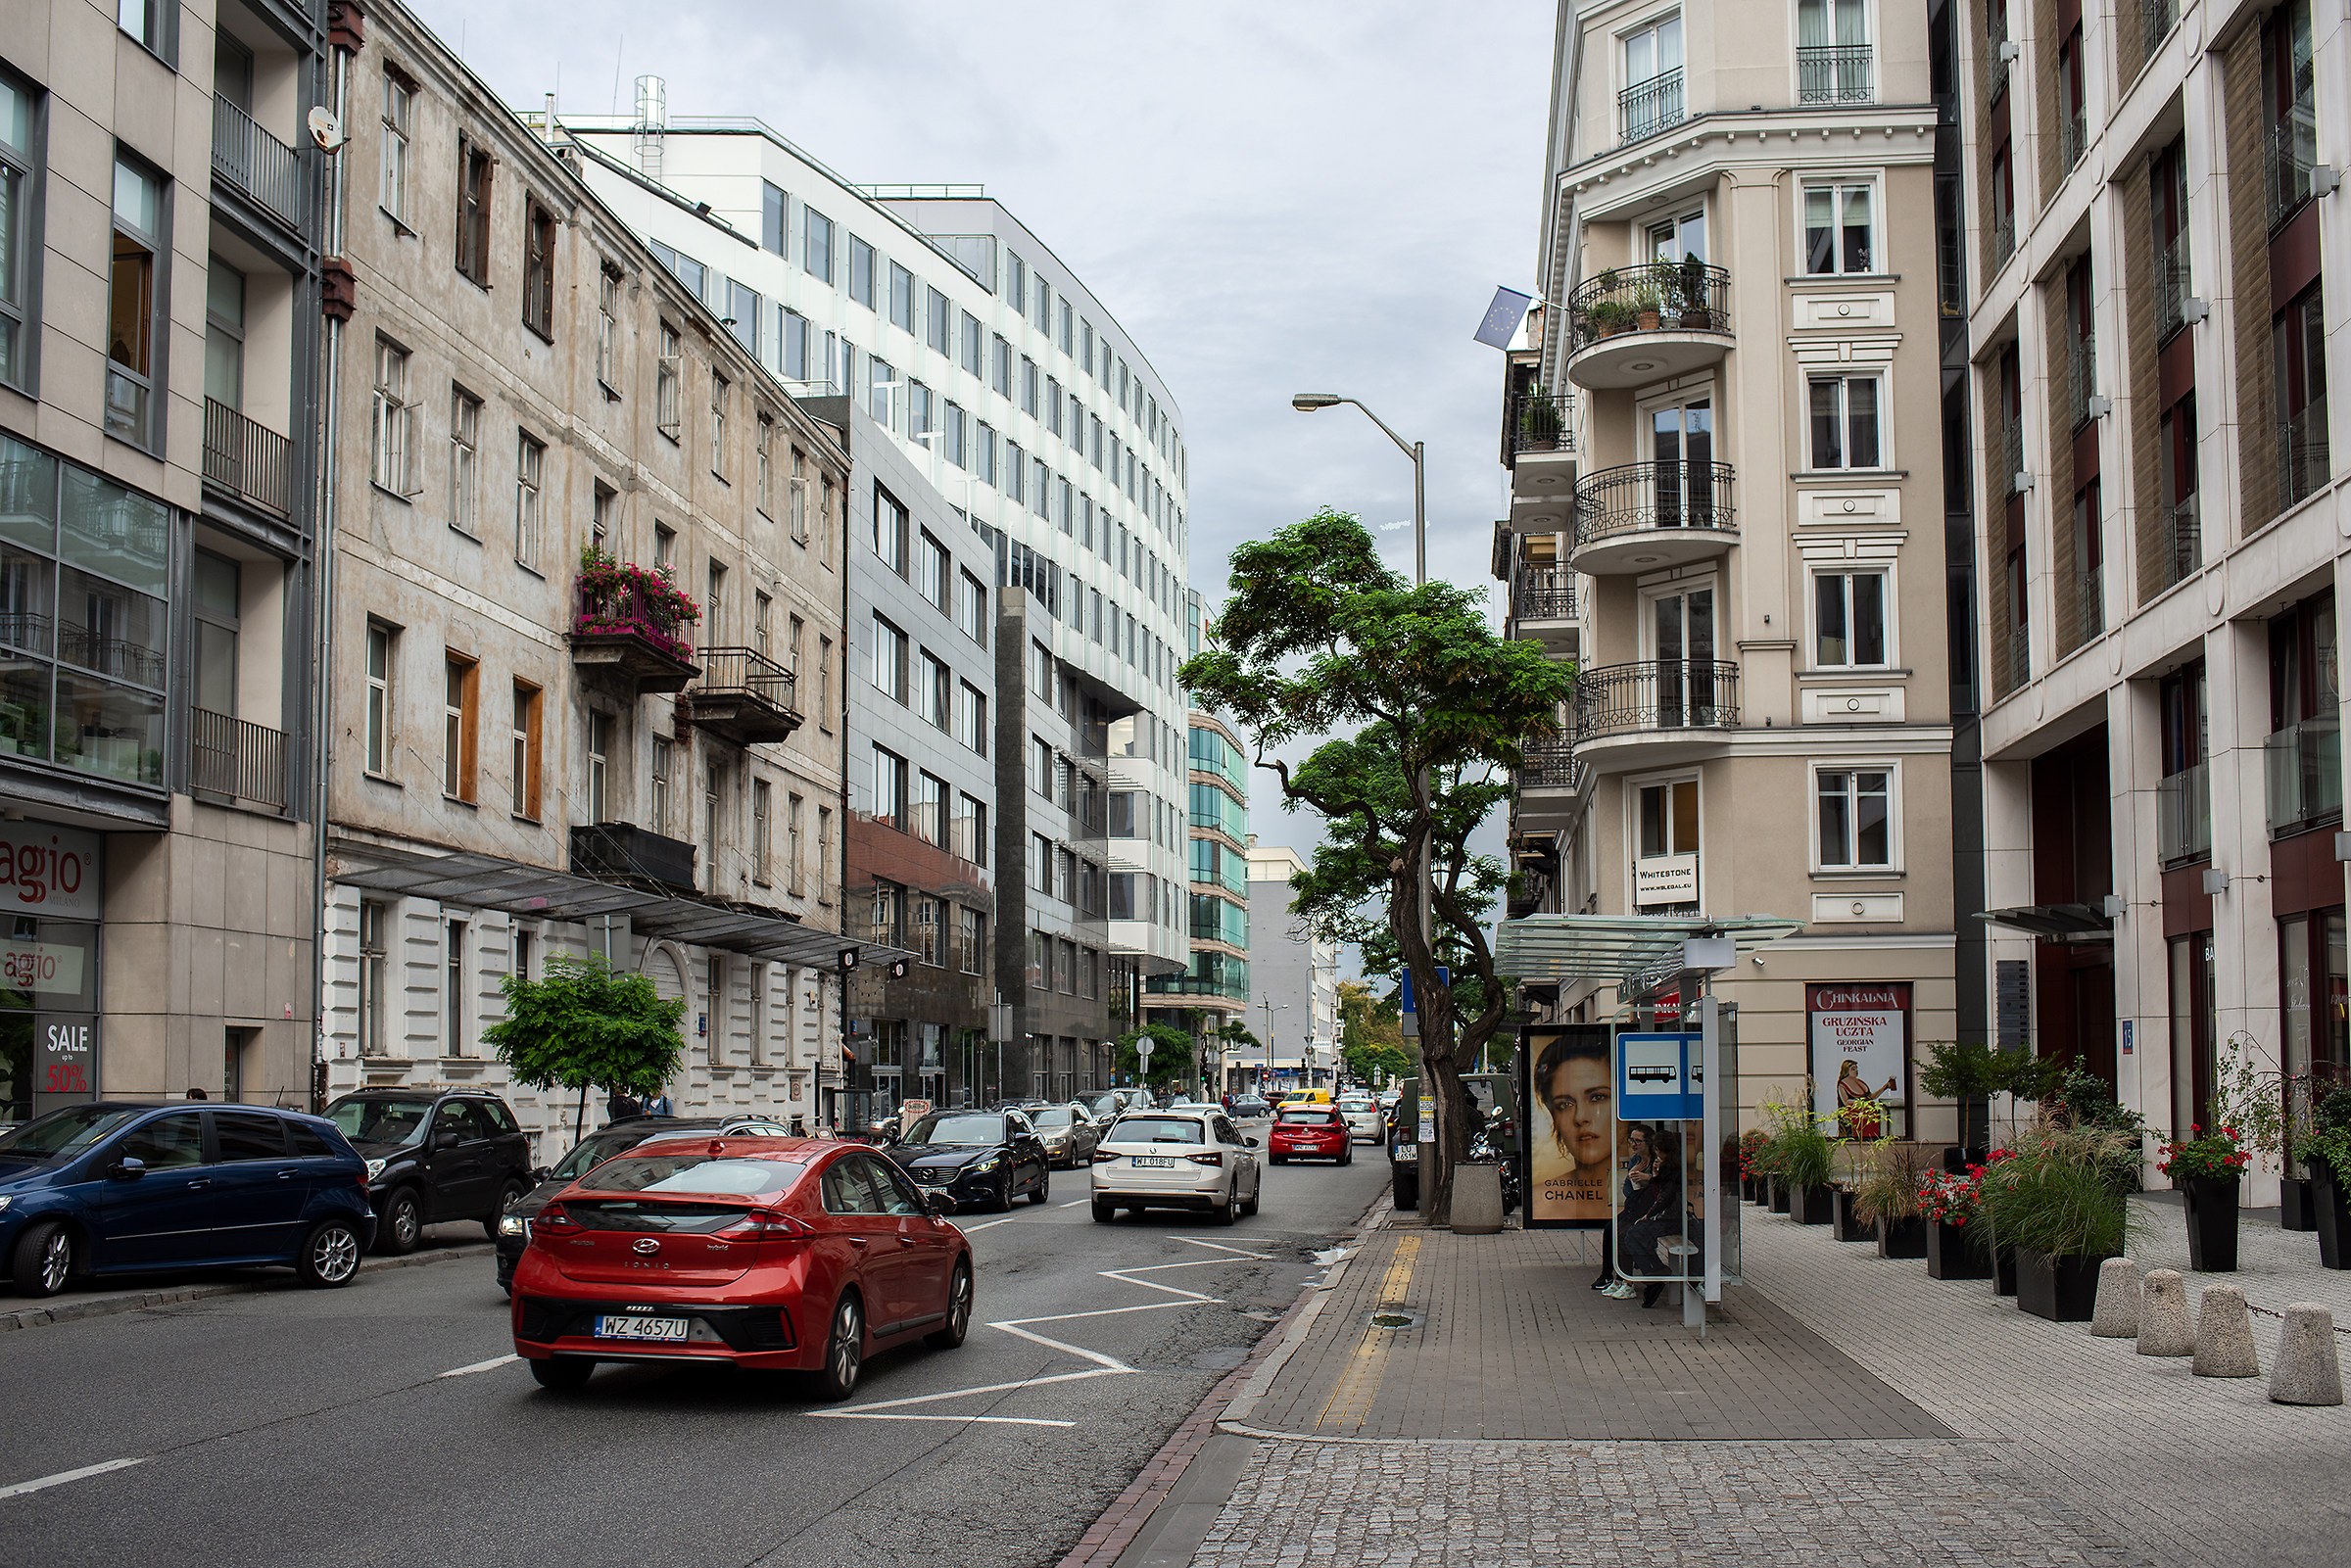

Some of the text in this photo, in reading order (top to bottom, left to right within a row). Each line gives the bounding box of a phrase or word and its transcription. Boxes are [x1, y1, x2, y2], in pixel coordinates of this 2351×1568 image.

[1639, 868, 1692, 879] WHITESTONE
[49, 895, 80, 908] MILANO
[1816, 989, 1898, 1010] CHINKALNIA
[1822, 1016, 1888, 1026] GRUZIŃSKA
[47, 1024, 88, 1052] SALE
[1835, 1027, 1874, 1036] UCZTA
[2125, 1029, 2132, 1047] 15
[47, 1064, 87, 1092] 50%
[1545, 1190, 1604, 1201] CHANEL
[604, 1316, 687, 1337] WZ 4657U
